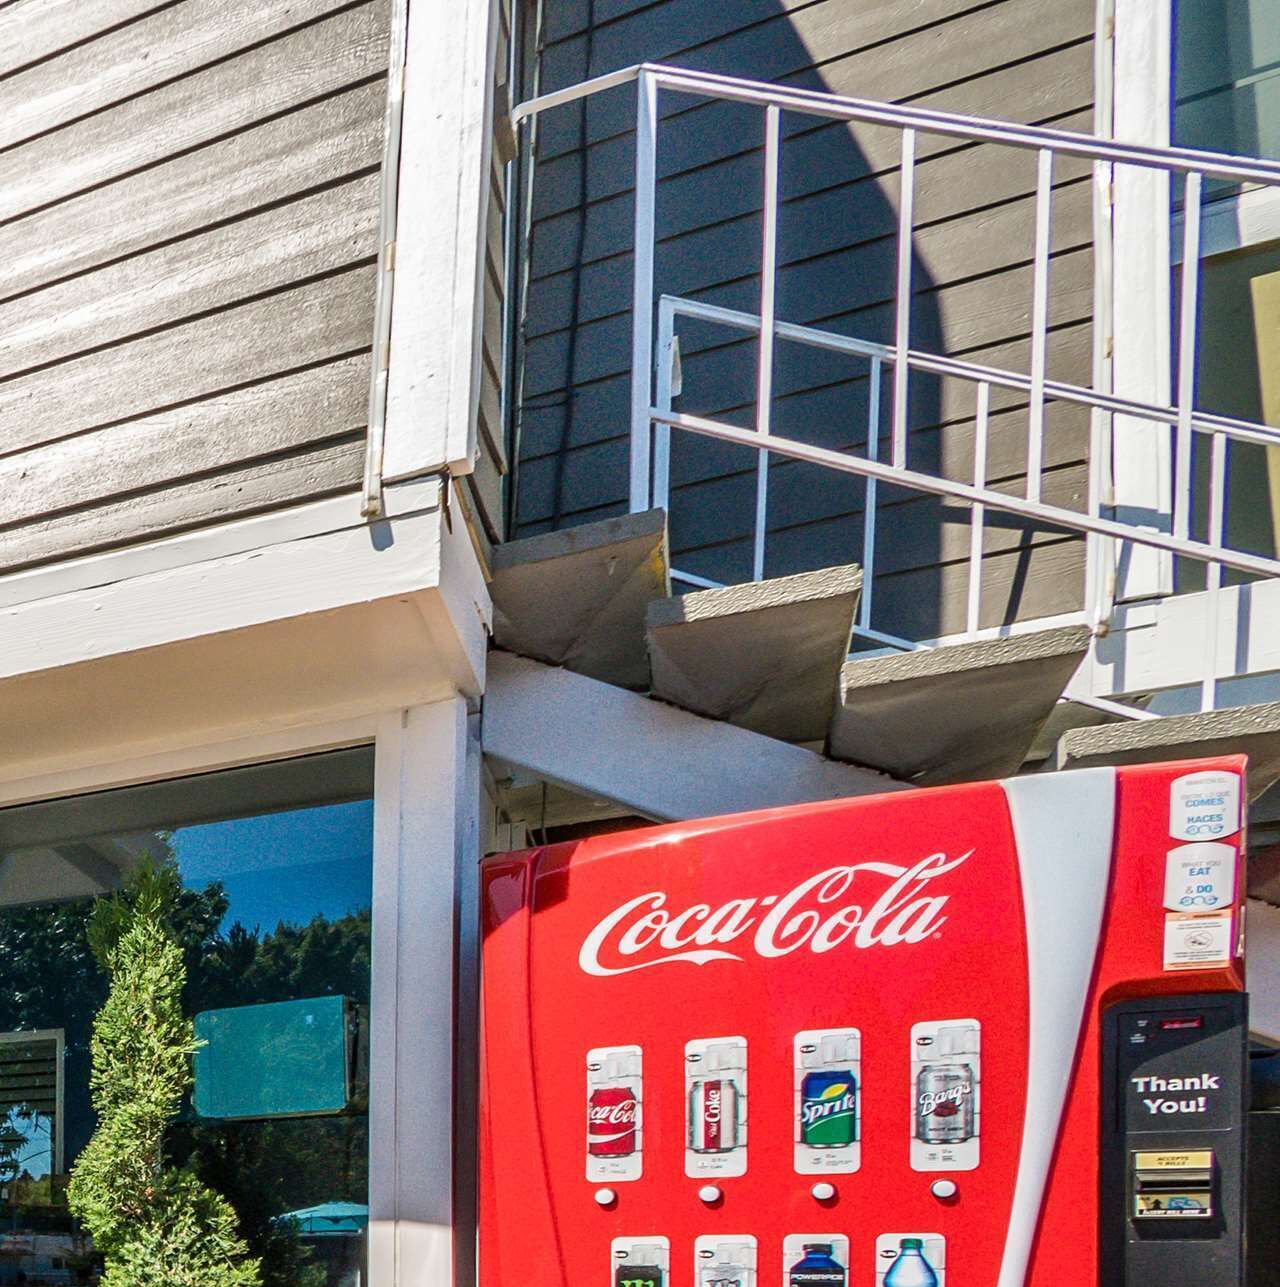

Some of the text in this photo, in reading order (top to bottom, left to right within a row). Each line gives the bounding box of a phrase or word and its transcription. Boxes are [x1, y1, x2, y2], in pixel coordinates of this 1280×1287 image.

[1185, 798, 1224, 808] COMES
[1187, 814, 1223, 824] HACES
[1189, 867, 1212, 876] EAT
[1196, 885, 1213, 894] DO
[578, 848, 976, 977] Coca-Cola
[1131, 1072, 1220, 1093] Thank
[704, 1088, 721, 1122] Coke
[801, 1093, 856, 1124] Sprite
[918, 1080, 972, 1117] Barq's
[1143, 1096, 1208, 1115] You!
